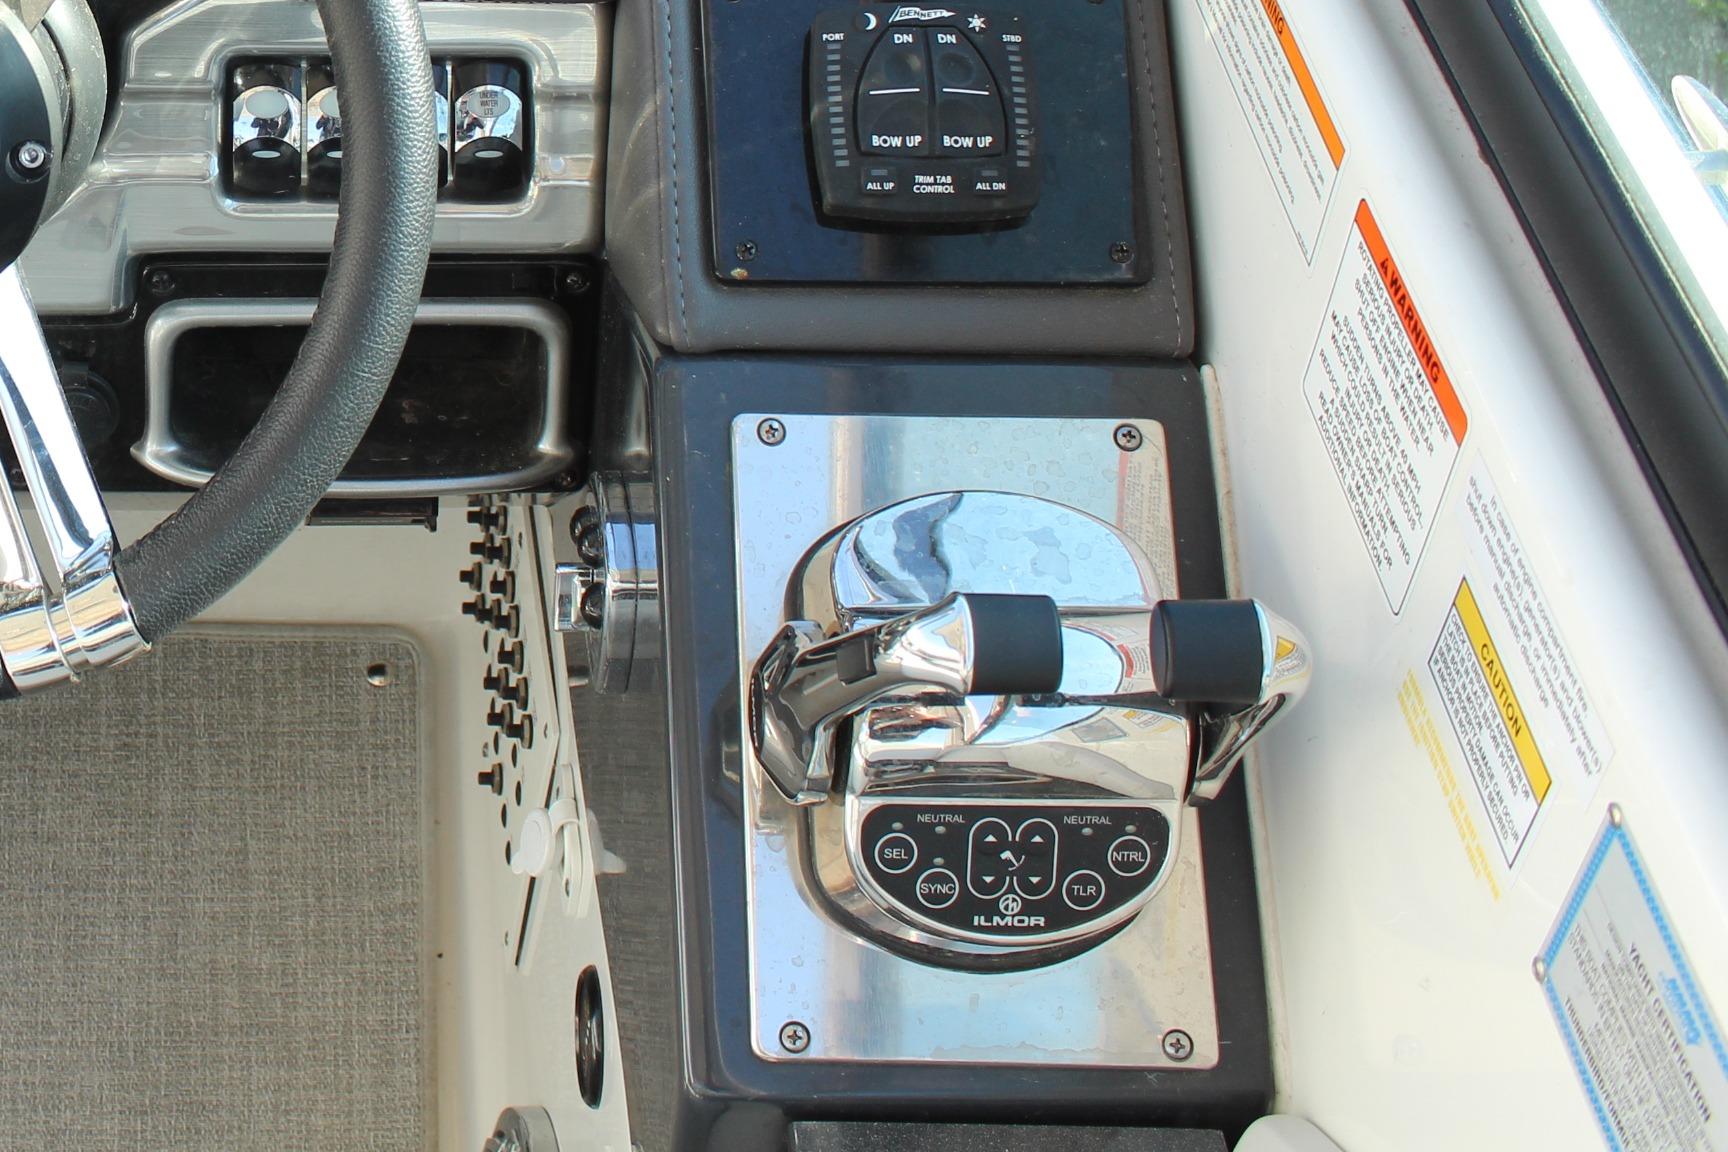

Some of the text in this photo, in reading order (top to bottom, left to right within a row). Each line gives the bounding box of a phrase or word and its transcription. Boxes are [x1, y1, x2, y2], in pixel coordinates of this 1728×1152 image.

[900, 9, 944, 18] BENNETT
[894, 34, 912, 43] DN
[938, 34, 956, 43] DN
[872, 136, 922, 146] BOW UP
[944, 136, 992, 147] BOW UP
[867, 182, 894, 190] ALL UP
[913, 185, 955, 193] CONTROL
[1388, 271, 1441, 387] WARNING
[1479, 640, 1522, 739] CAUTION
[917, 815, 964, 823] NEUTRAL
[1063, 816, 1111, 825] NEUTRAL
[884, 848, 908, 859] SEL
[1113, 851, 1144, 862] NTRL
[921, 883, 954, 894] SYNC
[1072, 885, 1095, 896] TLR
[973, 916, 1045, 926] ILMOR
[1627, 940, 1655, 998] YACHT
[1649, 994, 1714, 1125] CERTIFICATION
